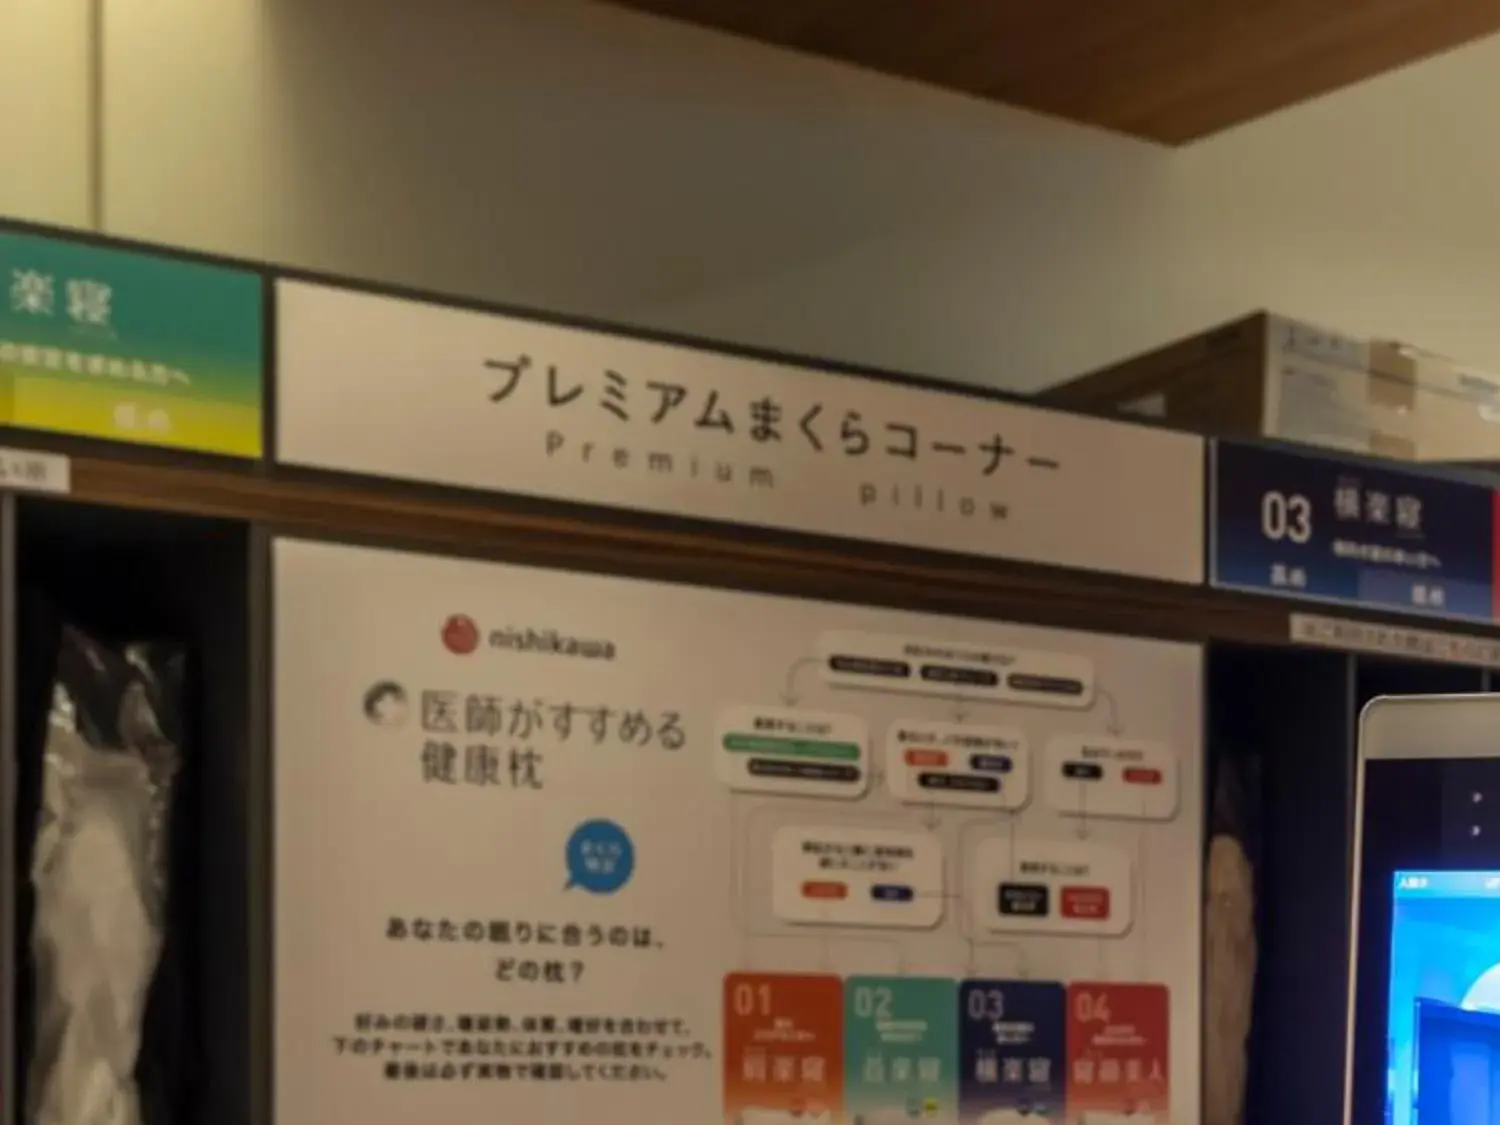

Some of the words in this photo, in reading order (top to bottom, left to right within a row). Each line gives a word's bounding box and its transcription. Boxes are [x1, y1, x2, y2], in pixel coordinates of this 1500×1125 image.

[484, 353, 1060, 477] プレミアムまくらコーナー
[546, 430, 776, 489] Premium
[1261, 490, 1312, 543] 03
[489, 626, 616, 661] nishikawa
[420, 690, 686, 751] 医師がすすめる
[420, 740, 543, 789] 健康枕
[734, 984, 772, 1016] 01
[854, 986, 893, 1017] 02
[967, 989, 1005, 1019] 03
[1075, 992, 1110, 1023] 04
